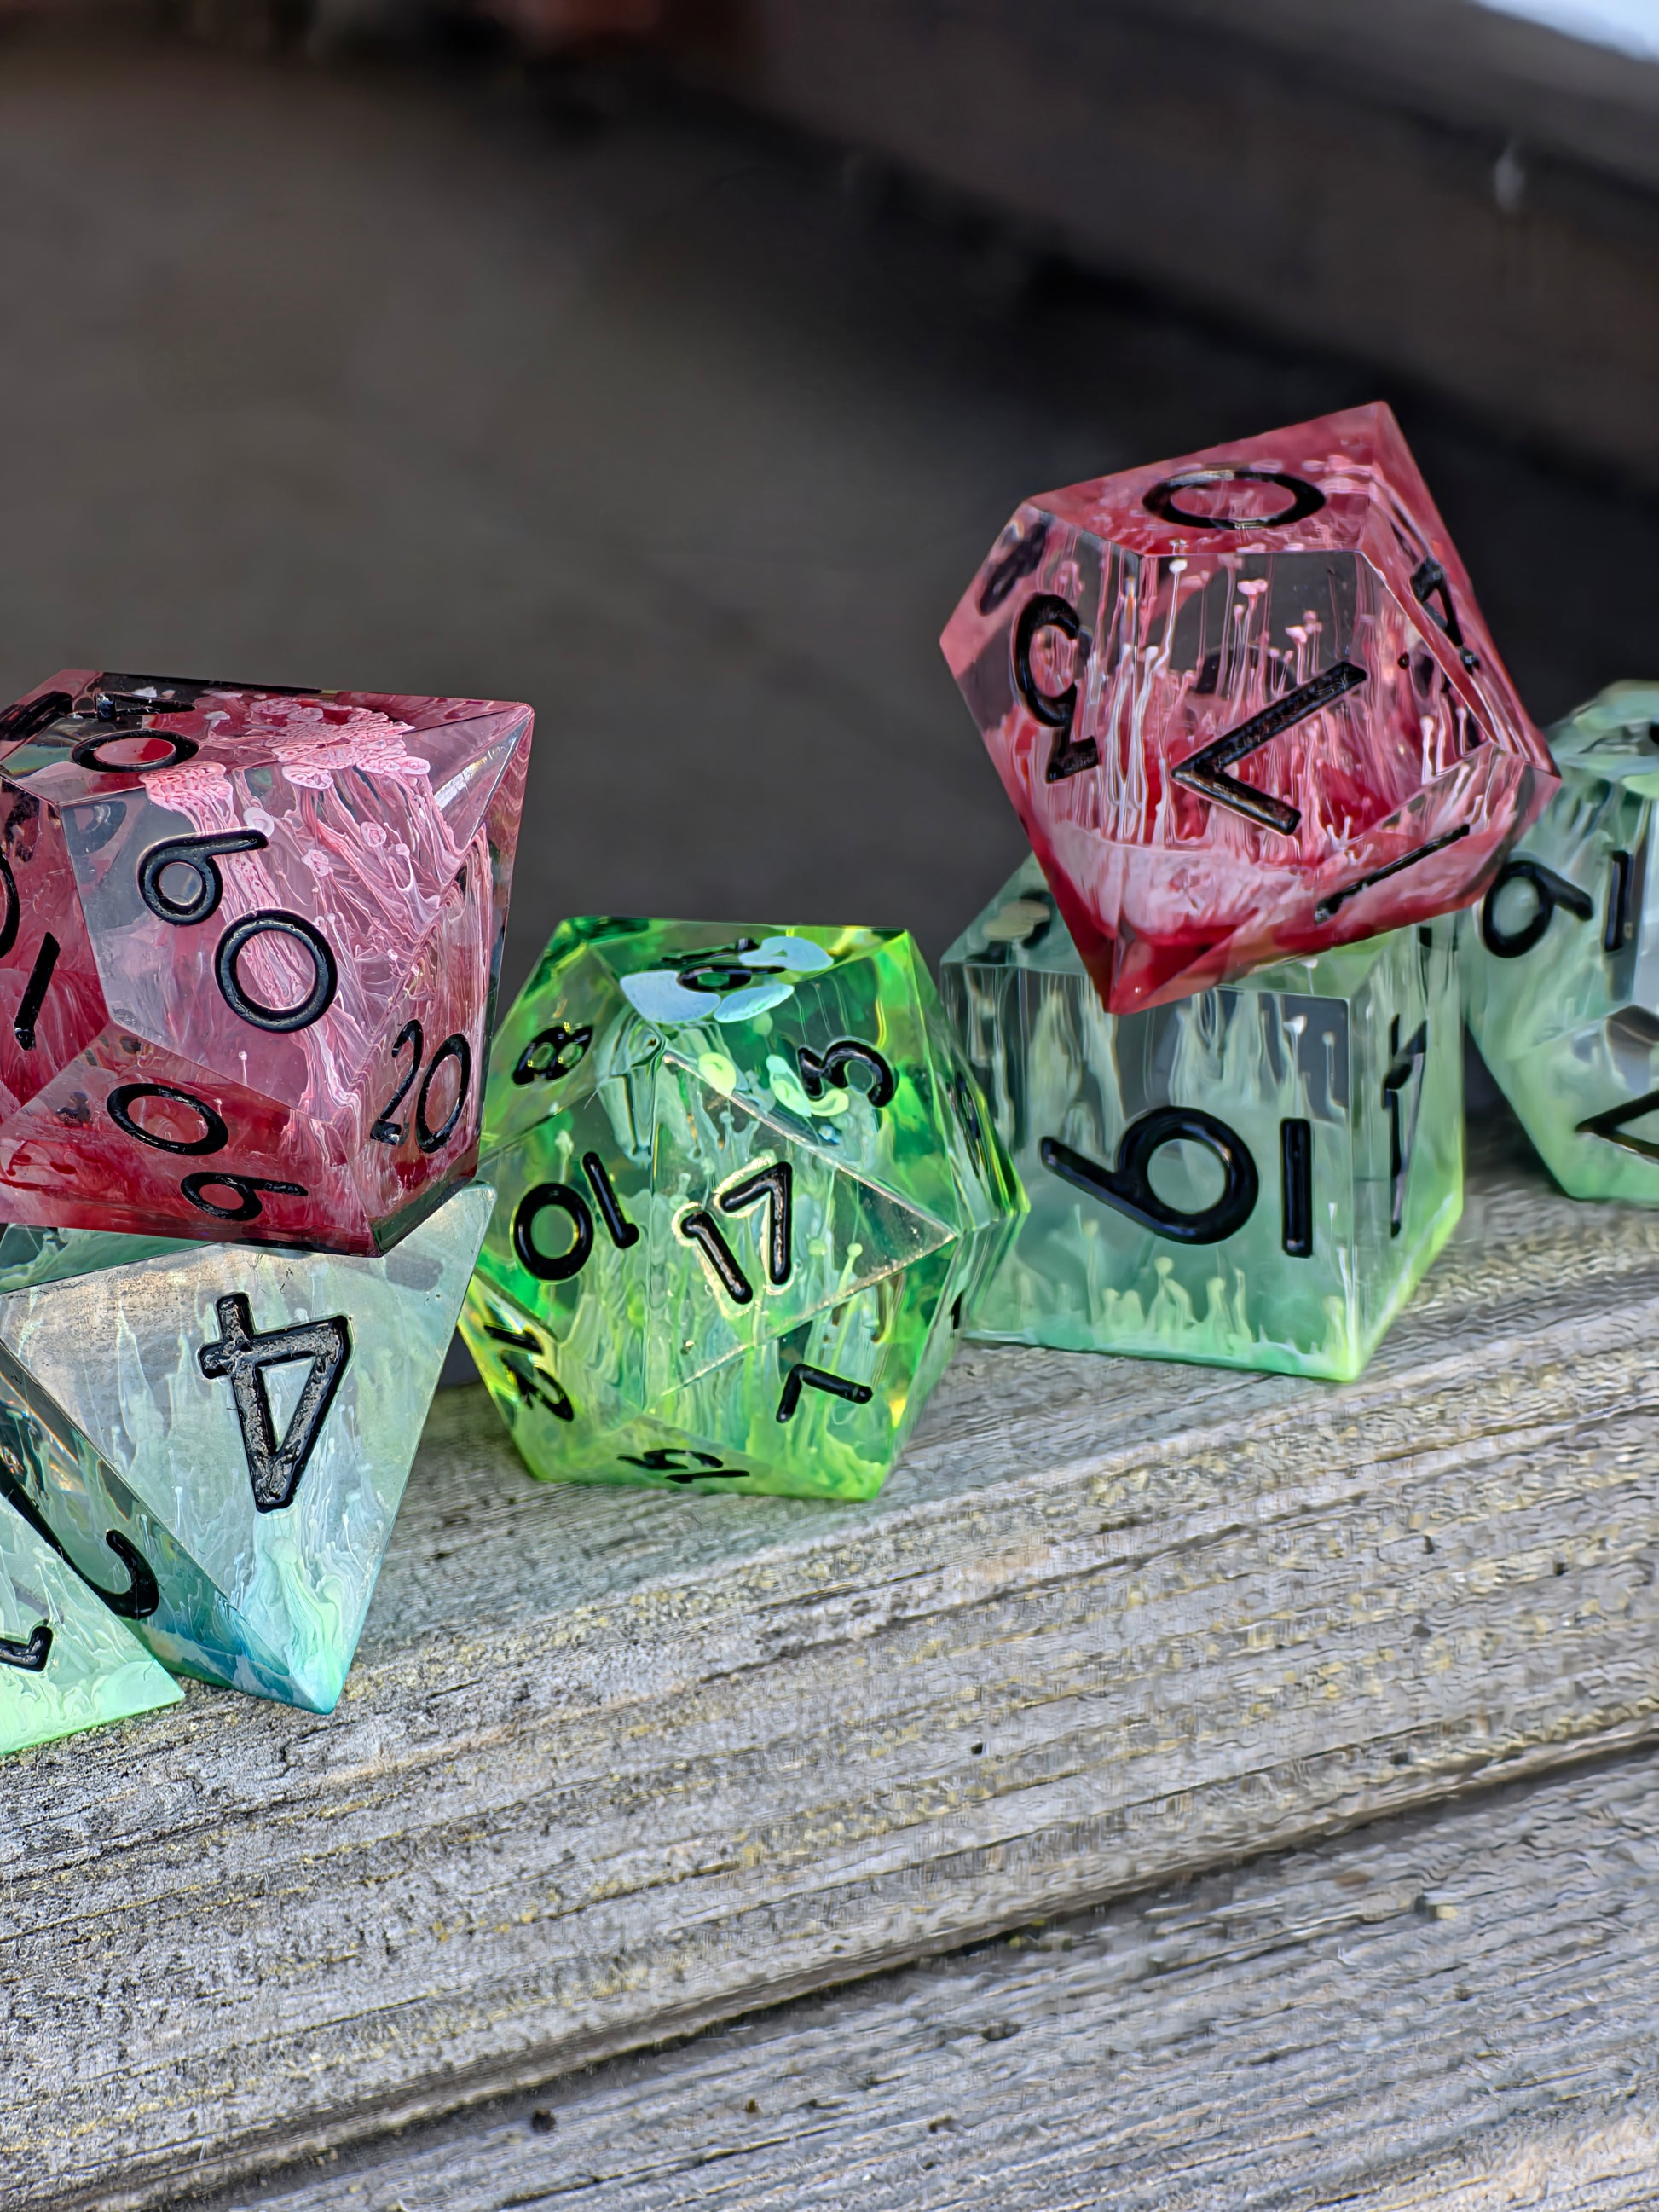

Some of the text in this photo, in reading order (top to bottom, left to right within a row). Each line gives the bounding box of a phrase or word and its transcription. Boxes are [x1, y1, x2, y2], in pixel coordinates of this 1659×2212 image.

[369, 1018, 472, 1155] 20
[679, 1160, 795, 1306] 17
[196, 1290, 353, 1514] 4
